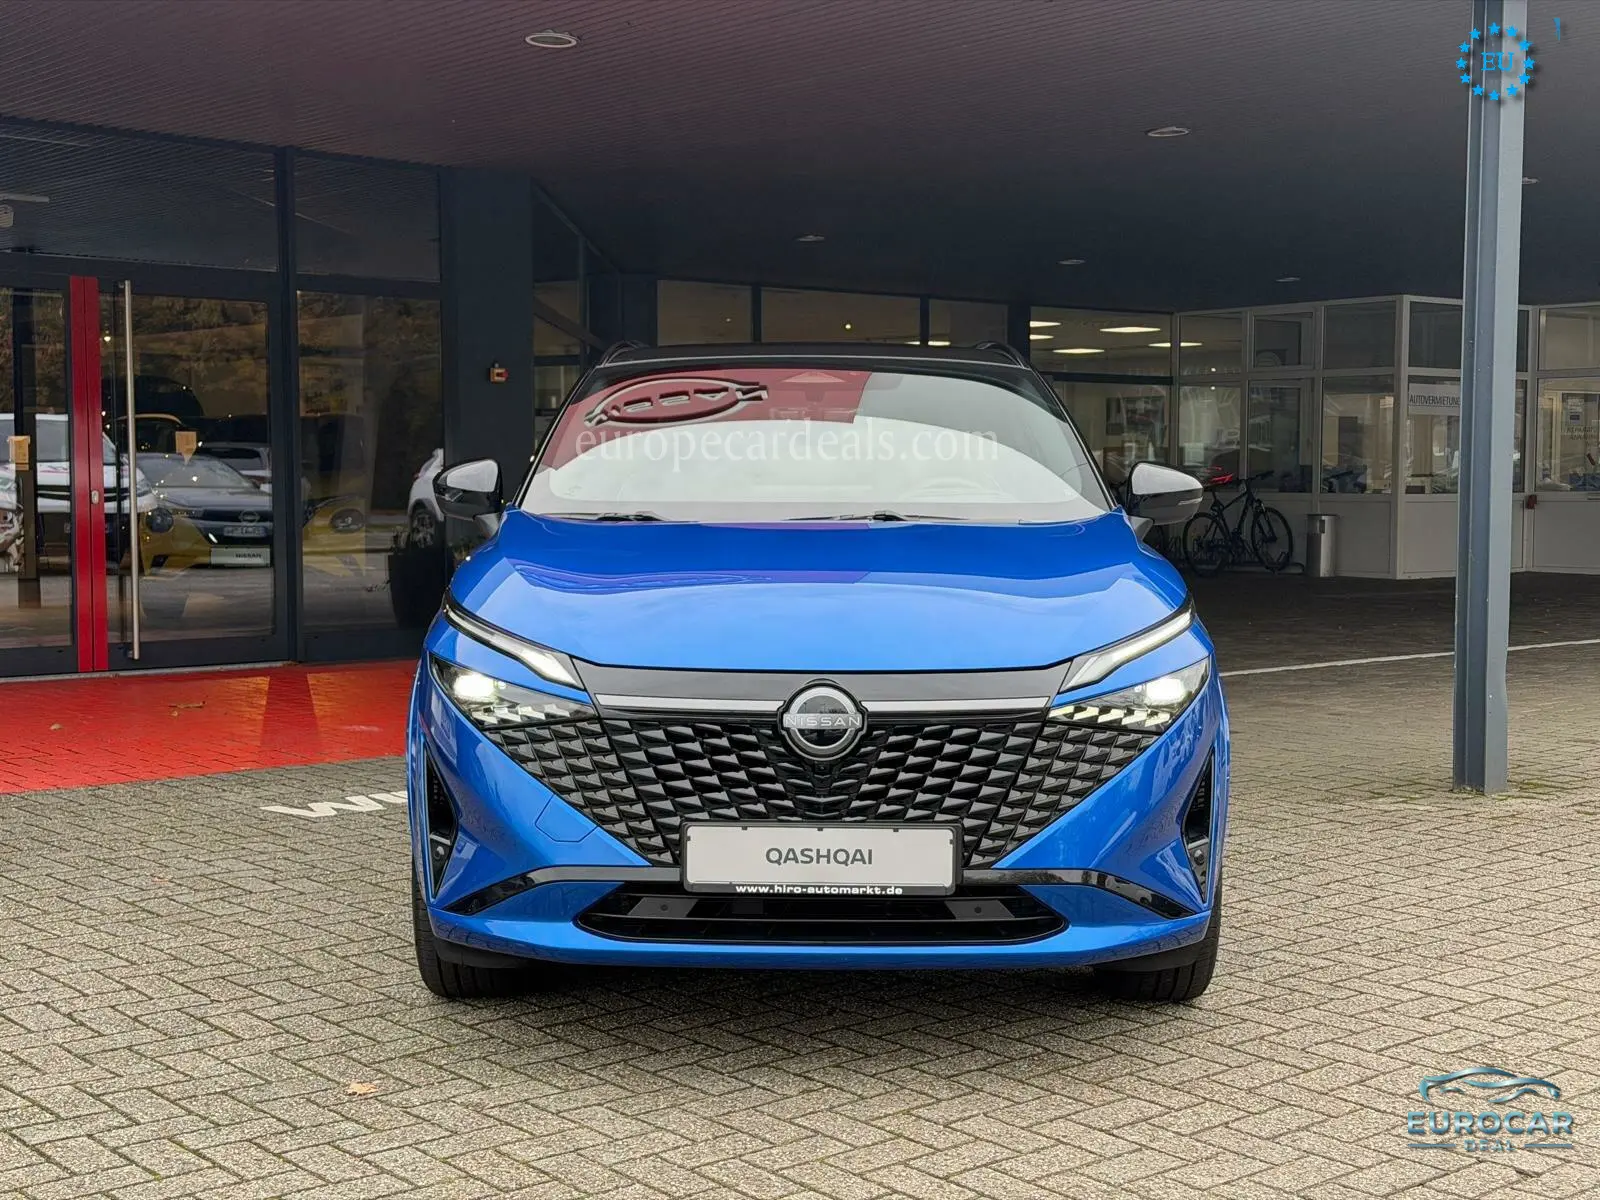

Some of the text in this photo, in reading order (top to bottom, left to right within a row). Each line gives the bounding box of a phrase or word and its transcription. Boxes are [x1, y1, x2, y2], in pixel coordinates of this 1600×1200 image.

[785, 715, 861, 727] NISSAN
[765, 847, 873, 867] QASHQAI
[735, 885, 903, 895] www.hiro-automarkt.de
